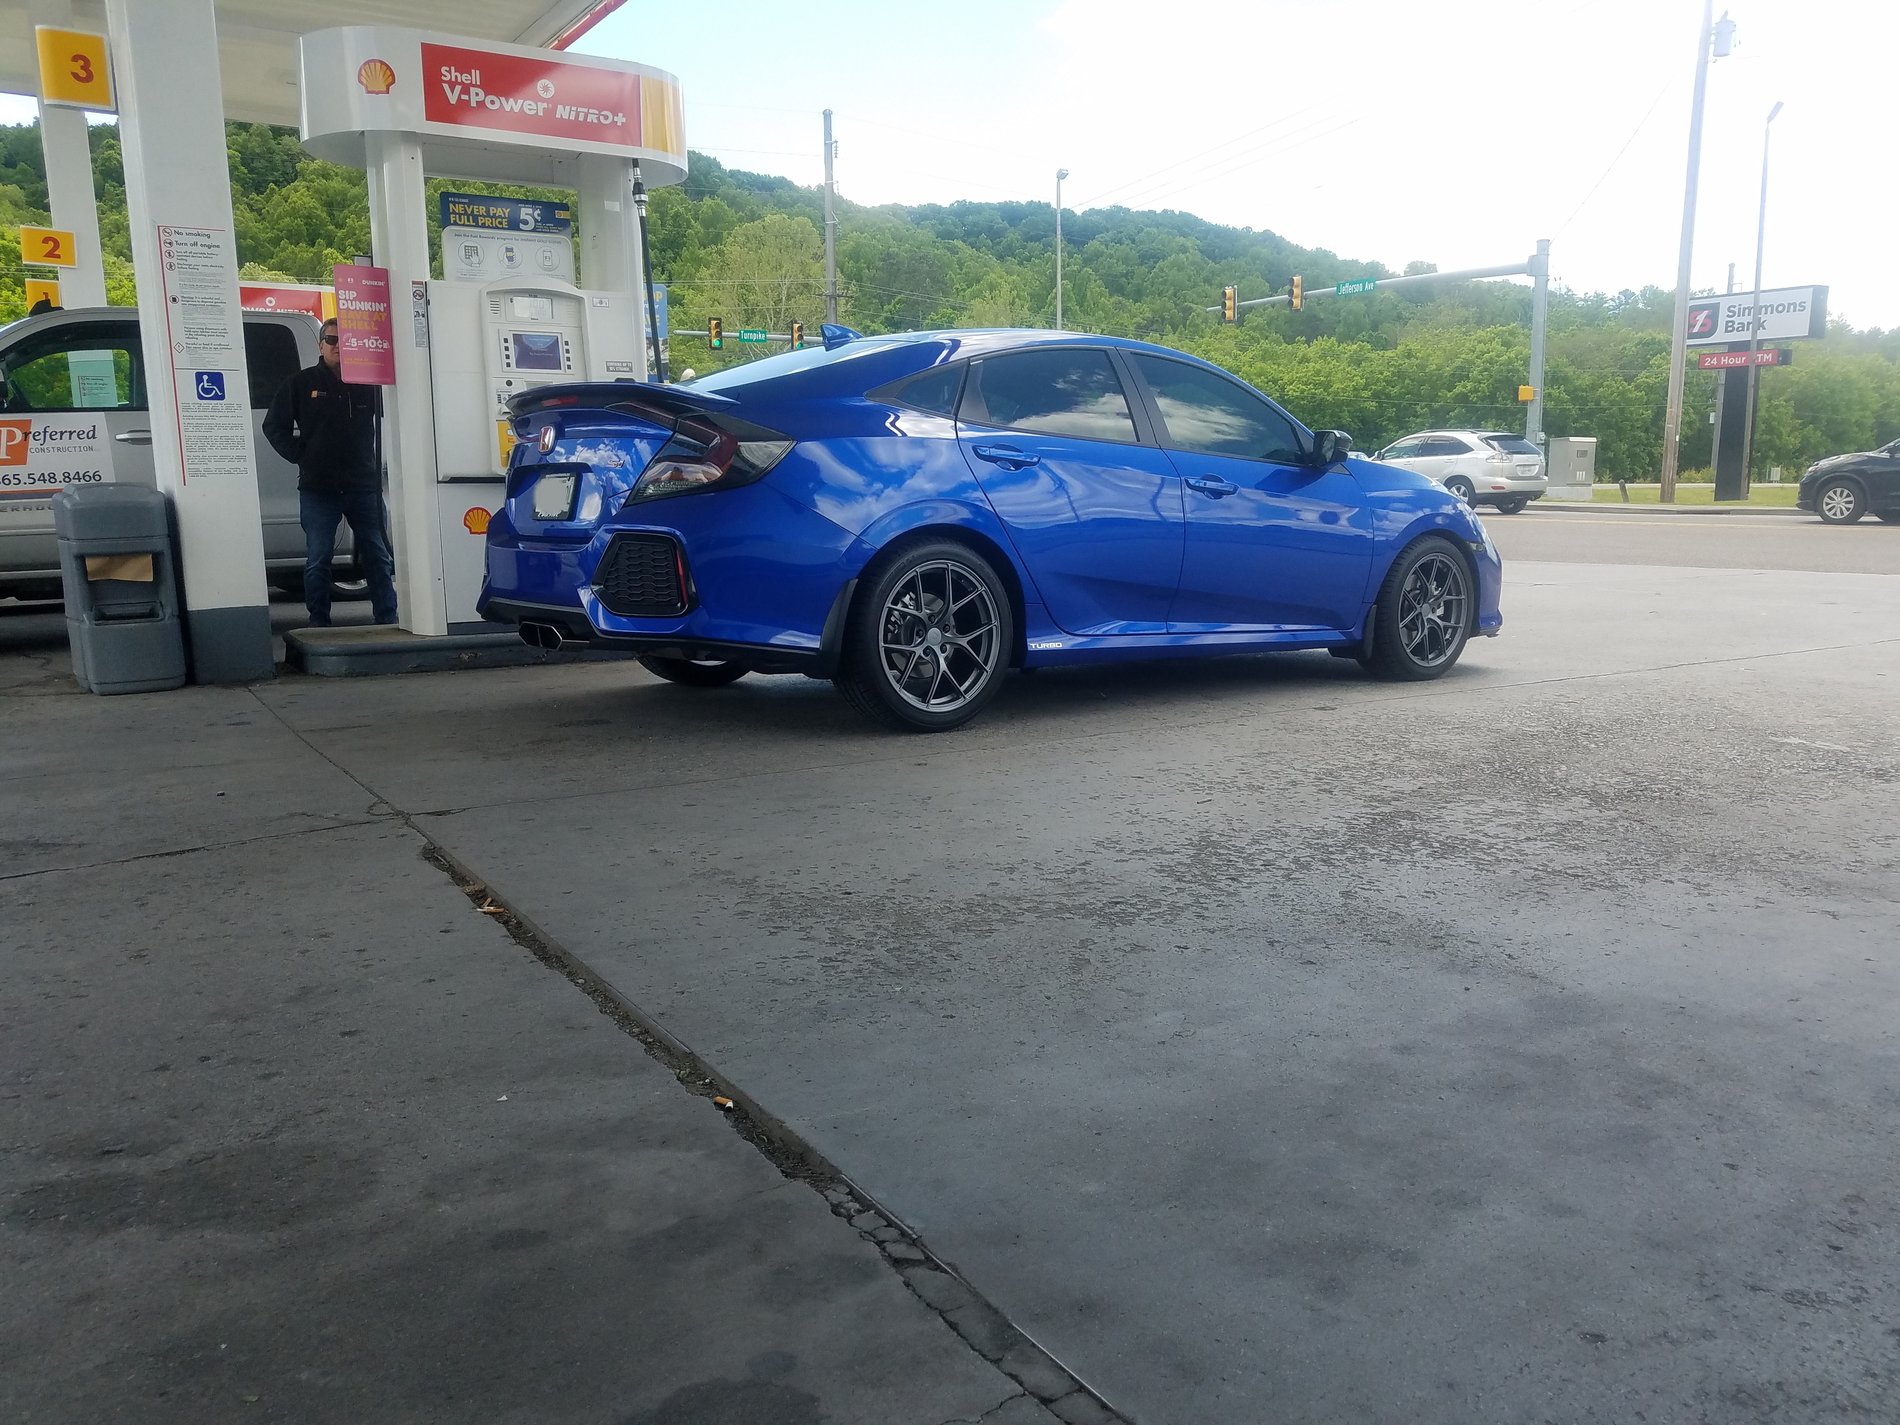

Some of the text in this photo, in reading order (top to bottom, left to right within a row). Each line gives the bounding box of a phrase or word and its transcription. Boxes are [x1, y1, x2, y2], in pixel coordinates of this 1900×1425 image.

[71, 54, 94, 83] 3
[441, 66, 480, 85] Shell
[442, 82, 548, 116] V-Power
[449, 203, 510, 218] NEVER PAY
[450, 214, 508, 228] FULL PRICE
[185, 231, 211, 239] smoking
[41, 236, 61, 259] 2
[338, 290, 357, 300] SIP
[1337, 281, 1374, 295] Jefferson Ave
[339, 300, 387, 312] DUNKIN'
[1726, 301, 1807, 318] Simmons
[1724, 318, 1767, 333] Bank
[740, 331, 766, 342] Turnpike
[1704, 353, 1772, 366] 24 Hour TM
[0, 425, 98, 459] Preferred
[29, 445, 94, 454] CONSTRUCTION
[0, 470, 102, 486] 65.548.8466
